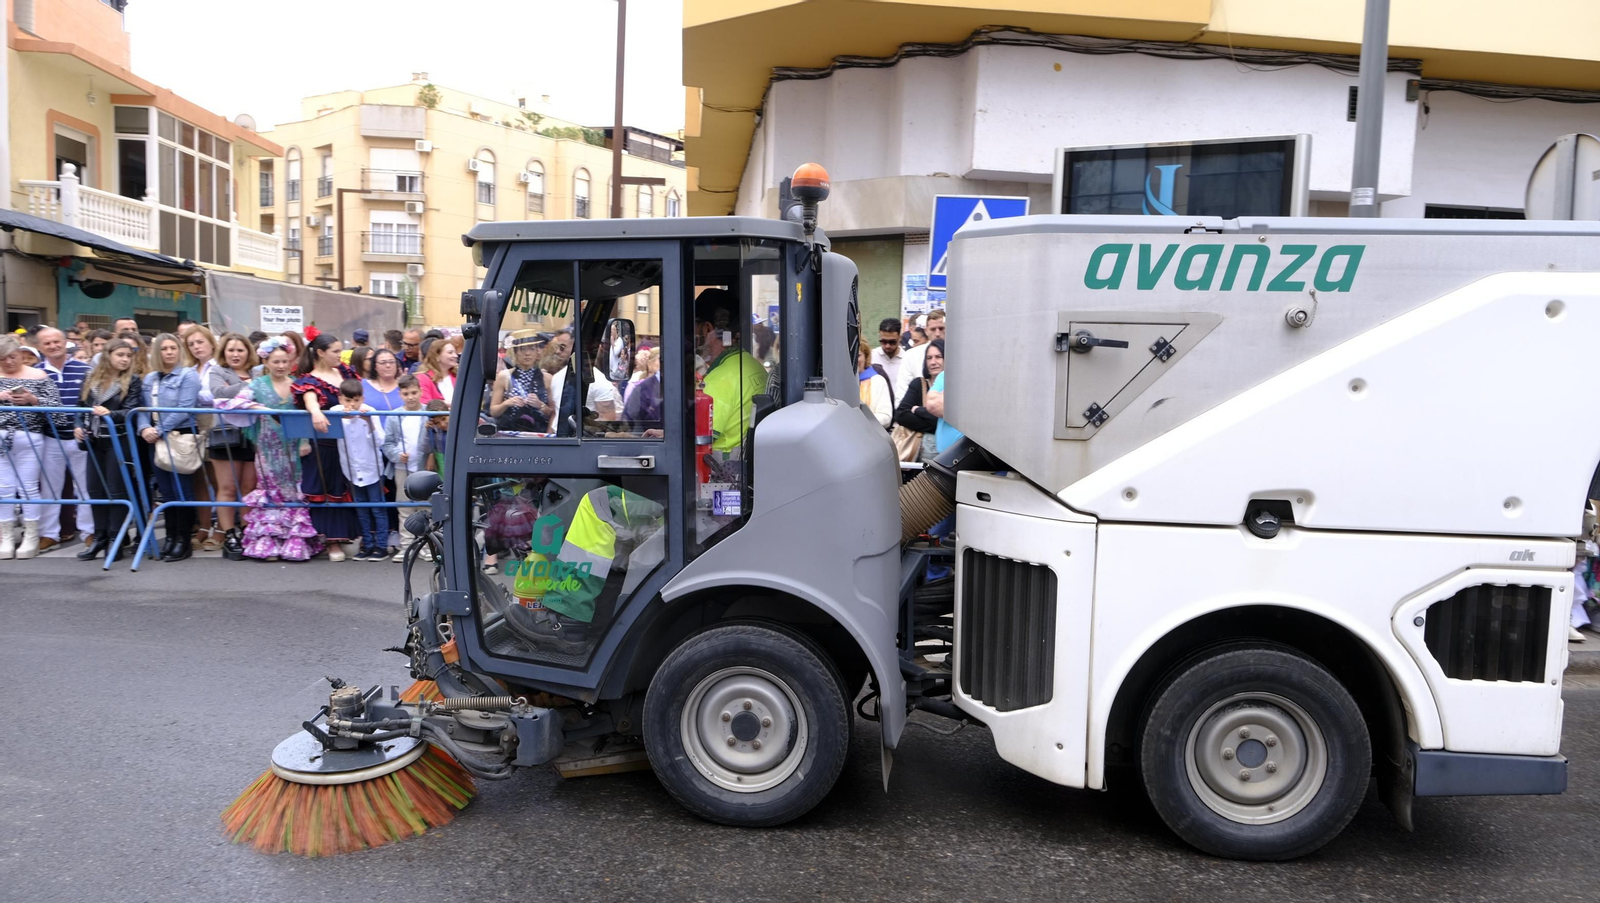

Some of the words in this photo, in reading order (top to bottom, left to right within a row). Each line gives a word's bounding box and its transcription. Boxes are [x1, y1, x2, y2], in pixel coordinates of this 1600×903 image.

[1084, 243, 1366, 292] avanza
[504, 560, 593, 579] avanza
[534, 573, 582, 592] verde
